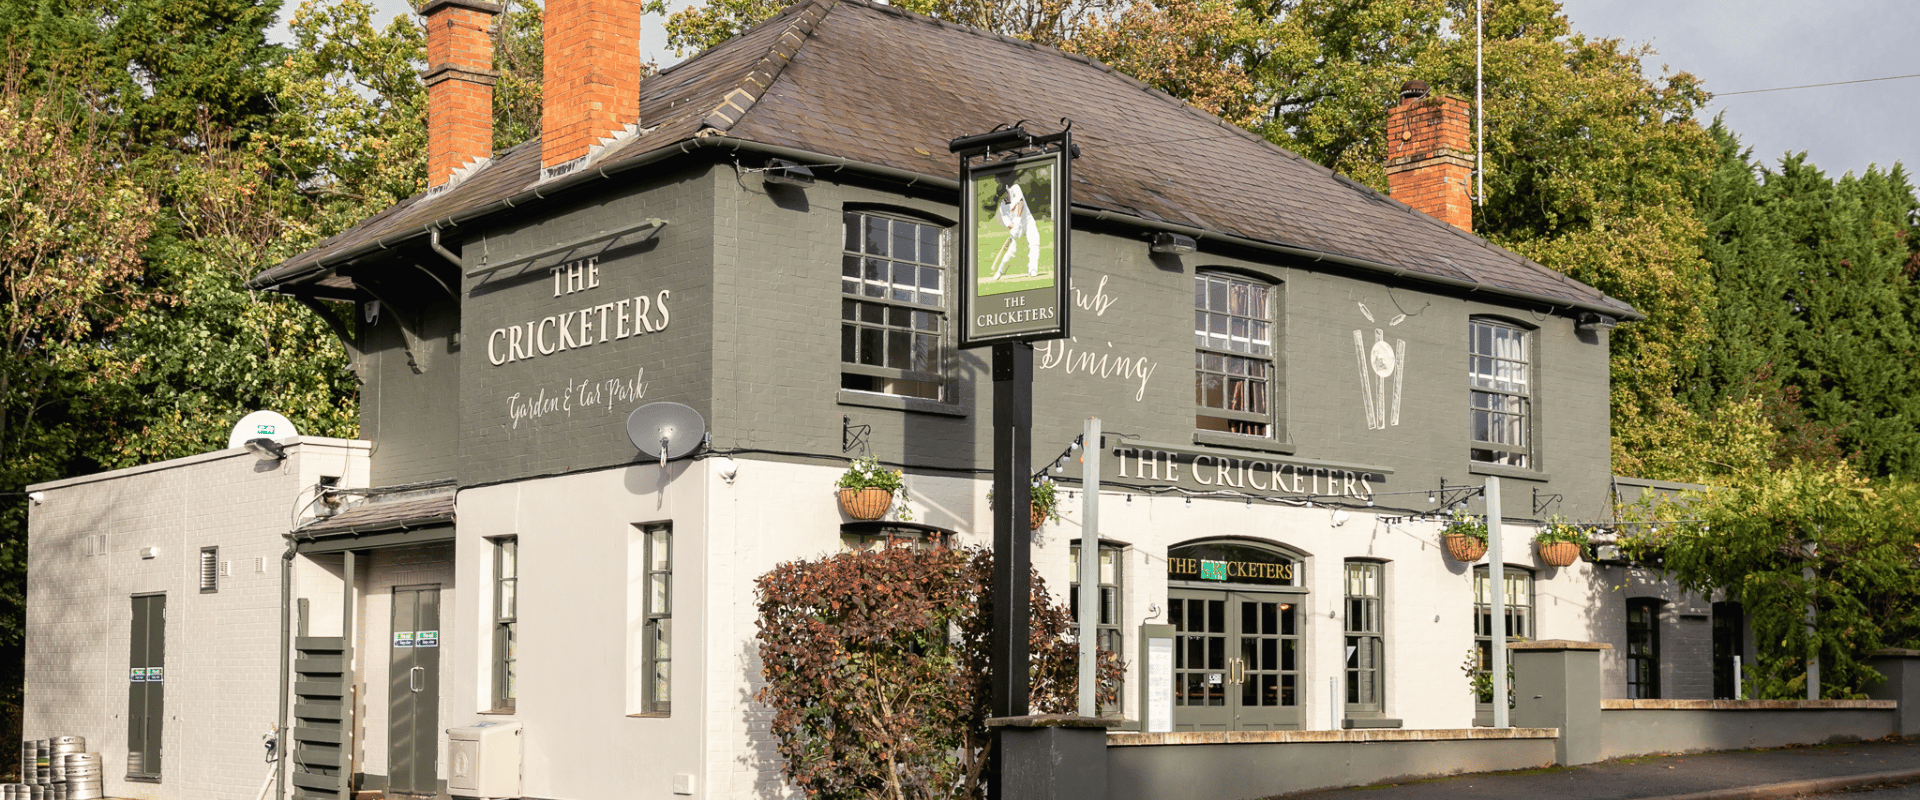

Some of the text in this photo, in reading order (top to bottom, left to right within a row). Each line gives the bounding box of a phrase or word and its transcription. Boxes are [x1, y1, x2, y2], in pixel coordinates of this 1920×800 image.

[550, 256, 600, 298] THE
[1070, 275, 1118, 317] ub
[977, 306, 1054, 327] CRICKETERS
[1003, 296, 1026, 308] THE
[487, 289, 670, 366] CRICKETERS
[1033, 336, 1158, 402] Dining
[506, 387, 560, 430] Garden
[576, 379, 602, 408] Car
[605, 366, 649, 411] Park
[1112, 447, 1373, 501] THE CRICKETERS
[1167, 557, 1198, 575] THE
